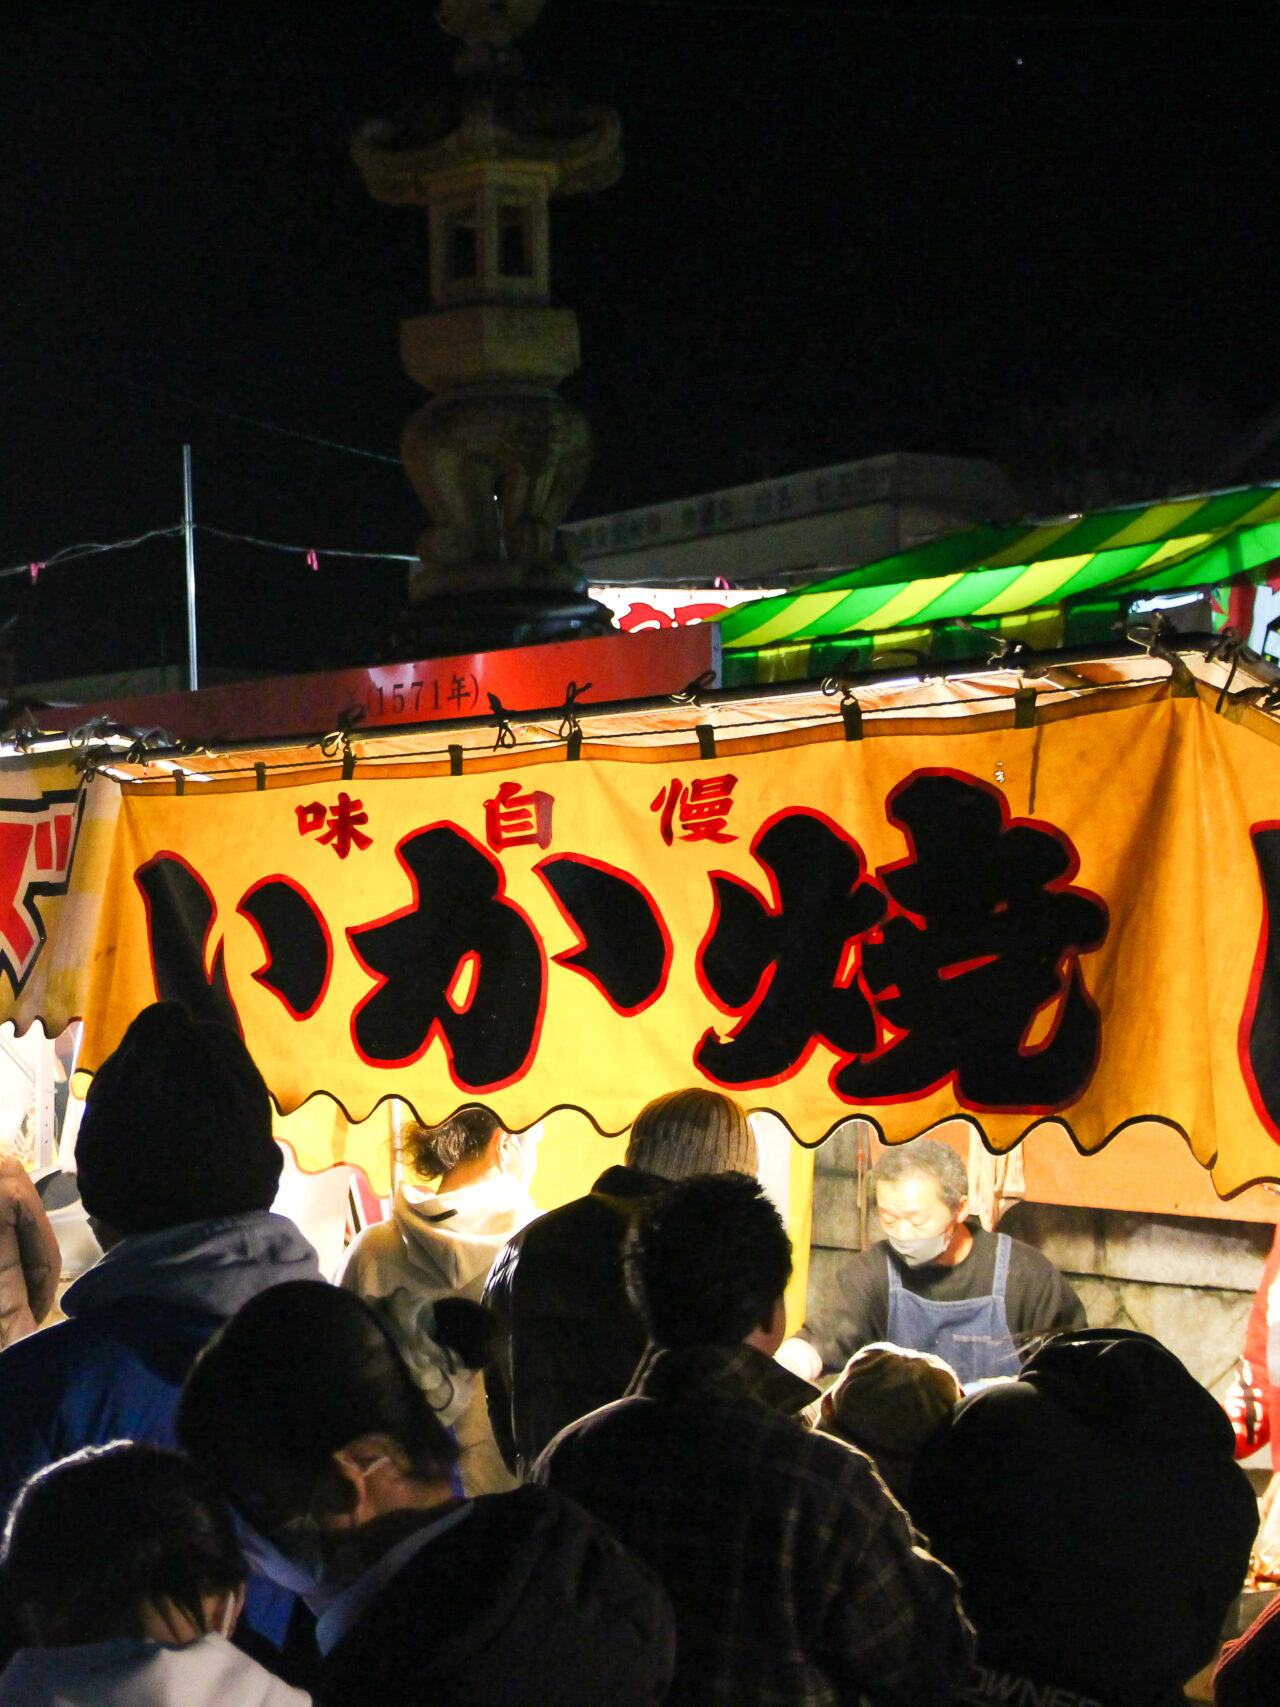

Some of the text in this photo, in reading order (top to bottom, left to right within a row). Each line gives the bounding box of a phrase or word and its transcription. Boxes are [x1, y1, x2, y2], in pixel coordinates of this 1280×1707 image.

[295, 773, 738, 859] 味自慢
[133, 767, 1111, 1114] いか焼
